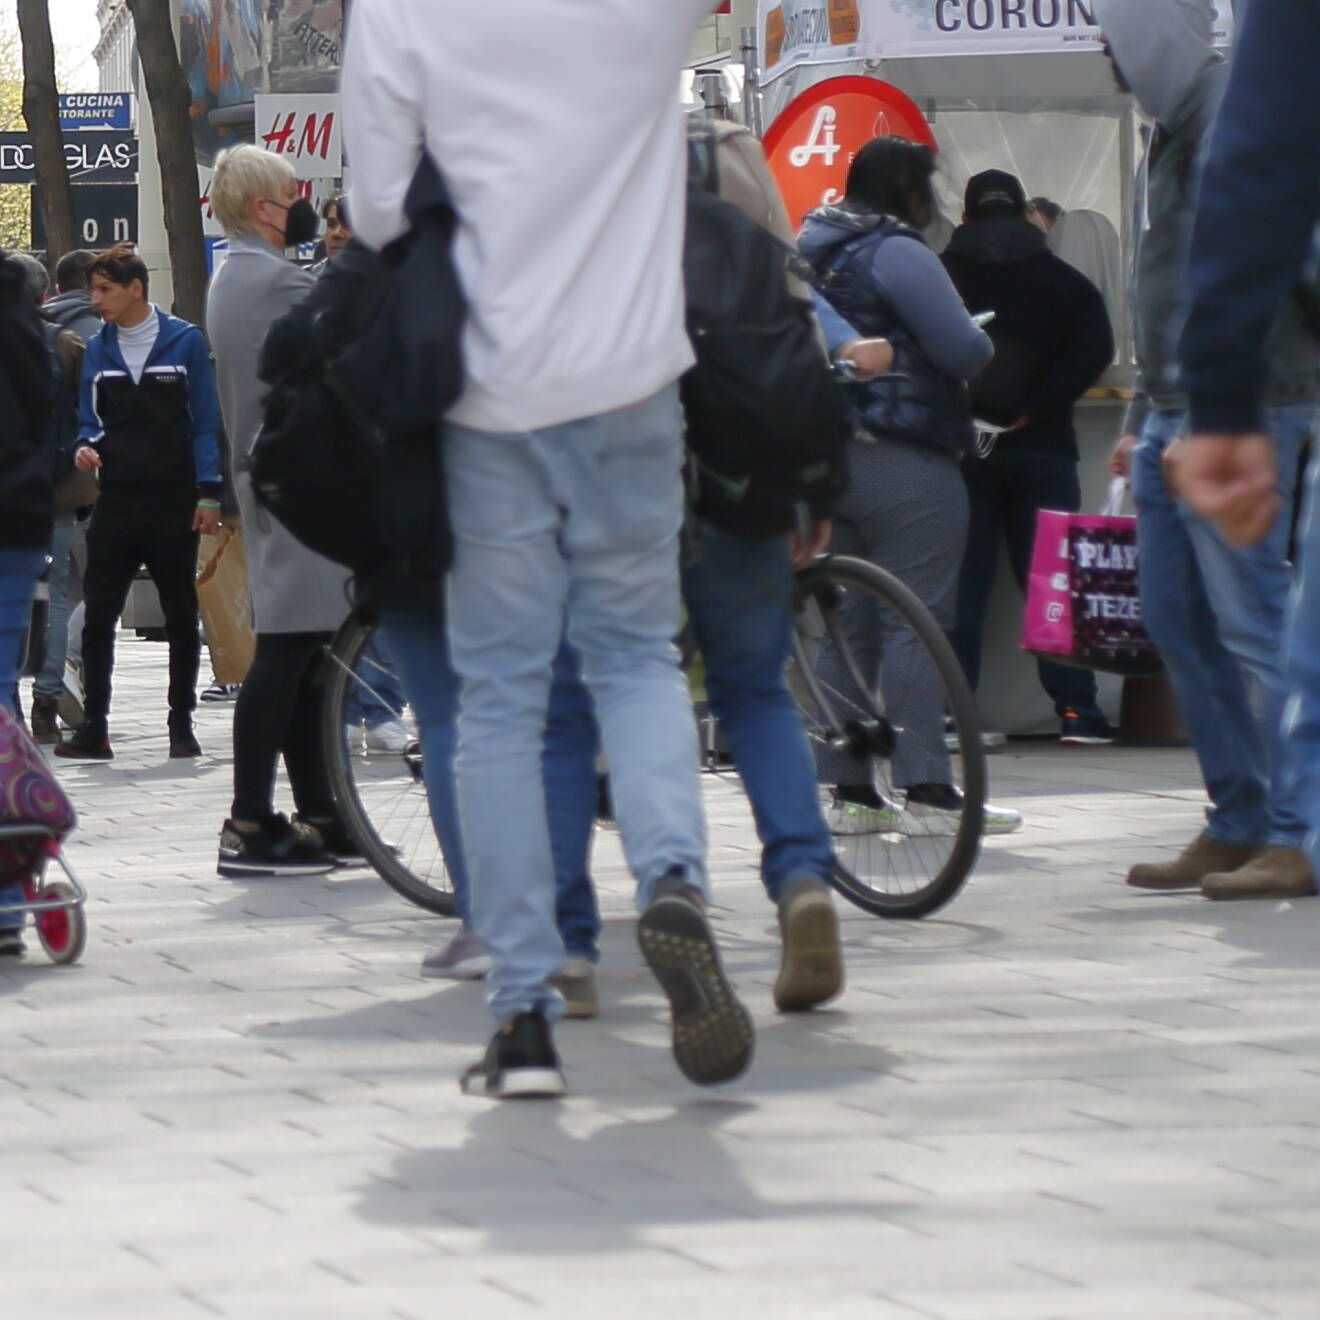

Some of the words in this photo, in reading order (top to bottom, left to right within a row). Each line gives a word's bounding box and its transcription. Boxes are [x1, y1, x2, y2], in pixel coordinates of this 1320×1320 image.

[66, 95, 123, 107] CUCINA
[261, 111, 334, 160] H&M
[0, 143, 131, 171] DOGLAS
